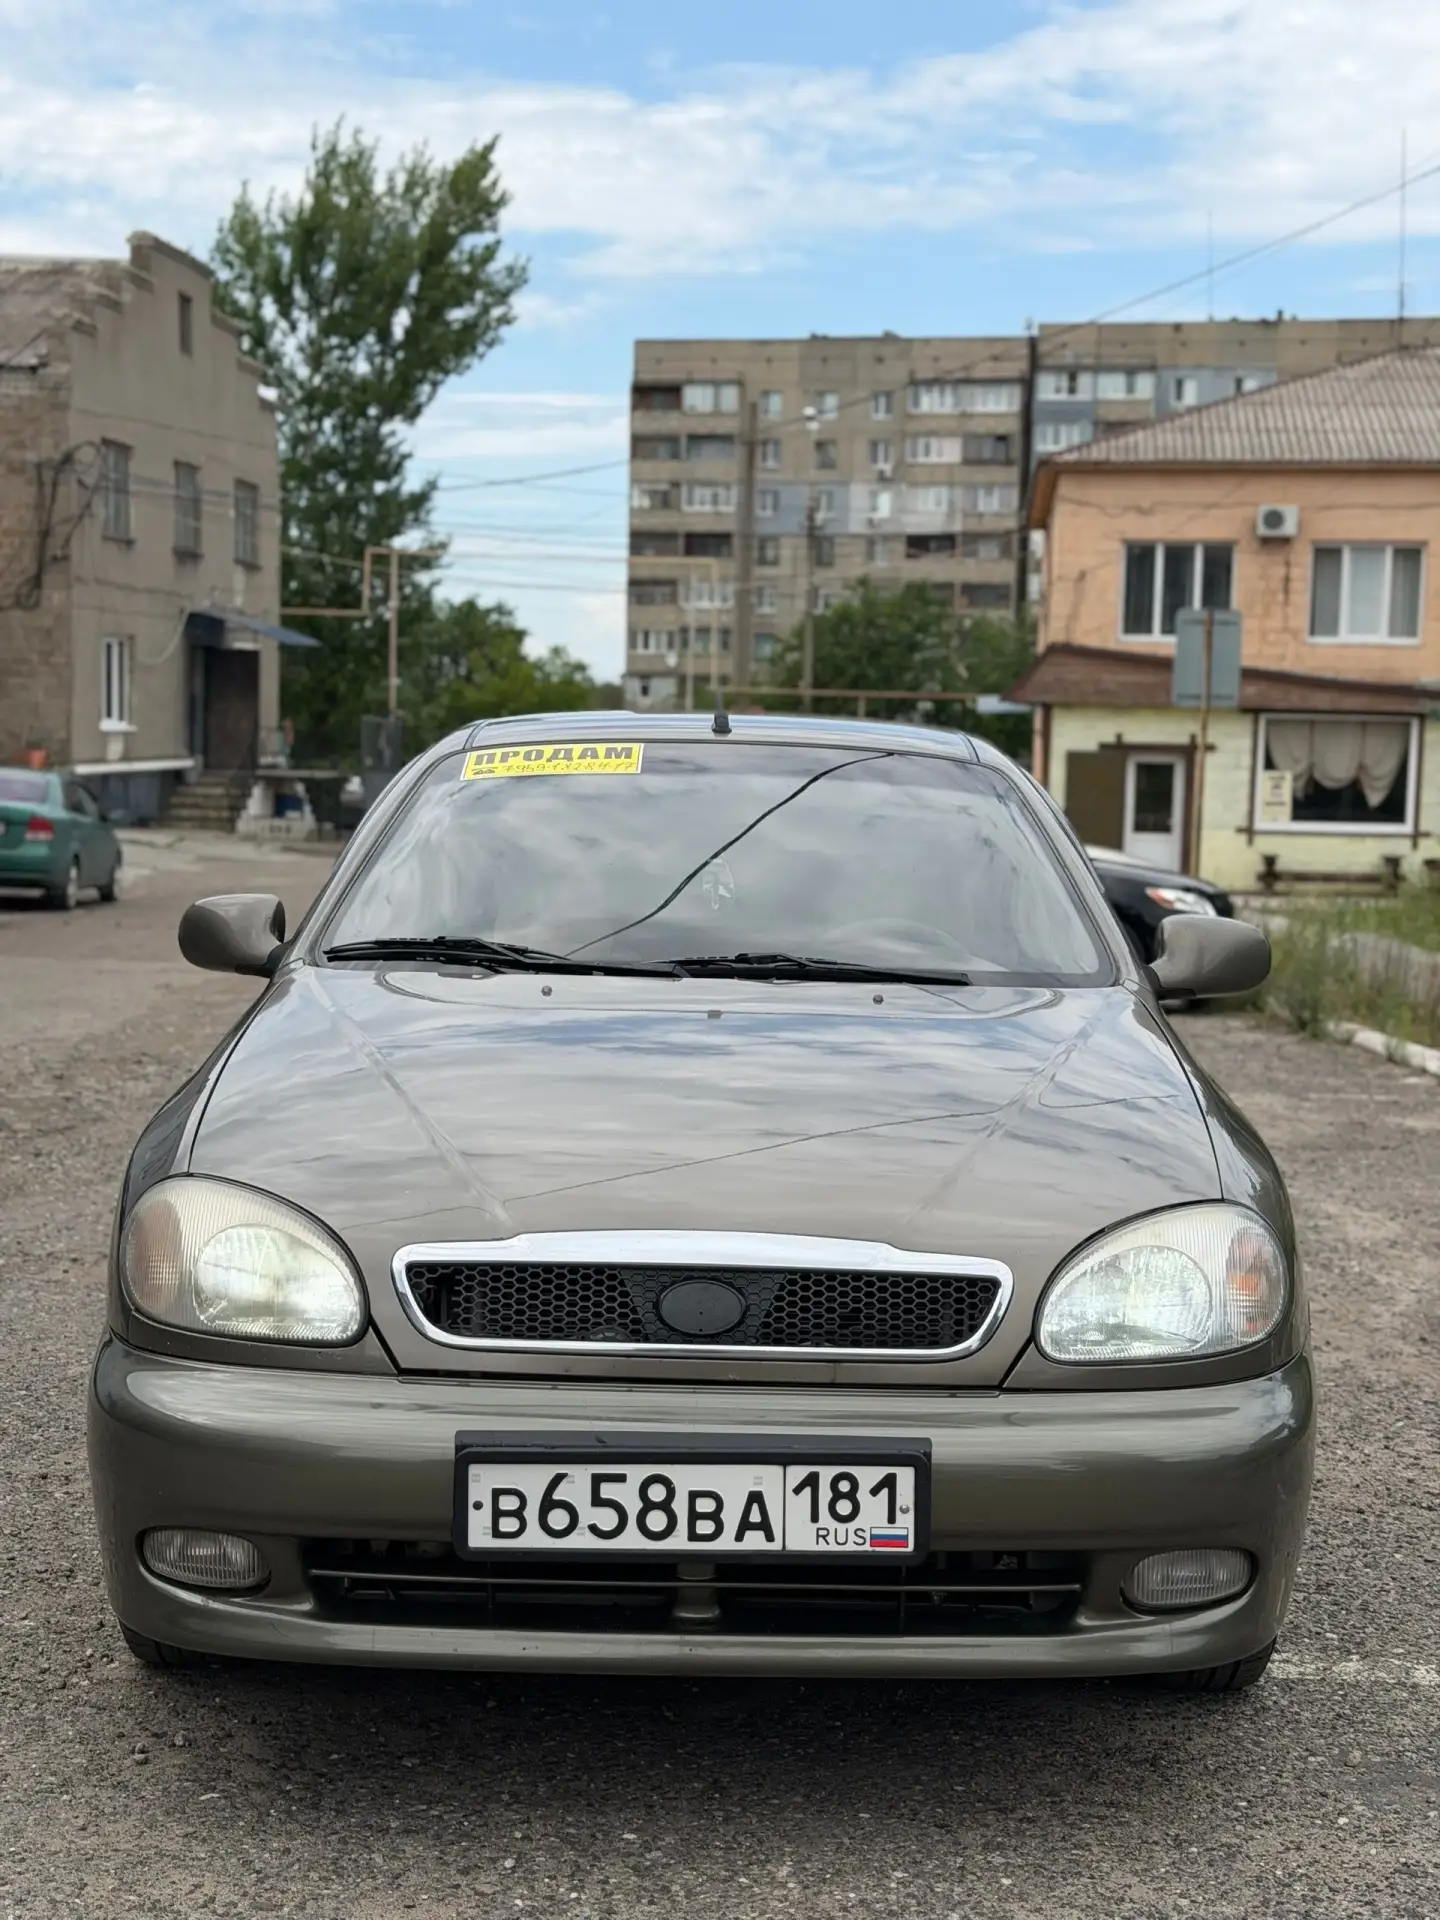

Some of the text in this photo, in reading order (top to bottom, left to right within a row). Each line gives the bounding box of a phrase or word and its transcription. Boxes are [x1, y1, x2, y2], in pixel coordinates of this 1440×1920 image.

[474, 747, 633, 766] ПРОДАМ
[792, 1471, 897, 1525] 181
[816, 1527, 866, 1546] RUS
